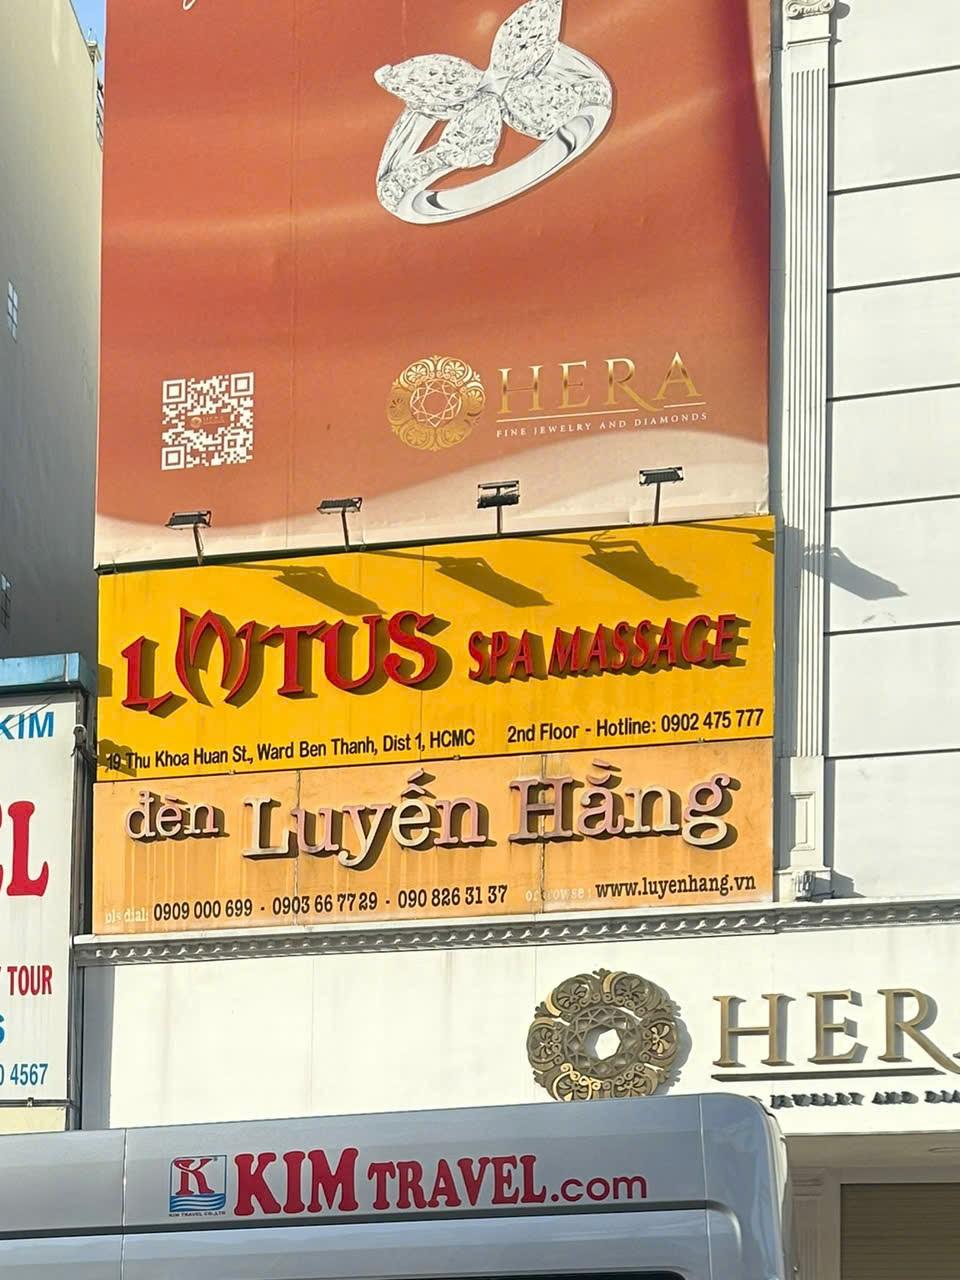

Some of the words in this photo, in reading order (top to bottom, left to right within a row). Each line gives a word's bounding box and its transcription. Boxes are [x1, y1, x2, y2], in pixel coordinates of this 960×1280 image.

[497, 351, 703, 414] HERA
[496, 426, 527, 438] FINE
[533, 422, 592, 435] JEWELRY
[599, 418, 627, 429] AND
[634, 411, 708, 427] DIAMONDS
[121, 607, 437, 711] LOTUS
[468, 629, 533, 682] SPA
[548, 613, 737, 675] MASSAGE
[507, 723, 537, 743] 2nd
[540, 721, 579, 741] Floor
[596, 714, 657, 737] Hotline:
[661, 713, 699, 734] 0902
[702, 711, 731, 731] 475
[735, 708, 764, 728] 777
[107, 753, 121, 770] 19
[125, 751, 151, 769] Thu
[155, 750, 189, 768] Khoa
[194, 747, 228, 764] Huan
[257, 741, 297, 760] Ward
[299, 738, 328, 757] Ben
[331, 736, 377, 757] Thanh,
[382, 733, 414, 753] Dist
[429, 729, 475, 749] HCMC
[125, 790, 219, 841] đèn
[243, 769, 487, 866] Luyến
[509, 758, 732, 846] Hằng
[153, 901, 190, 921] 0909
[193, 900, 221, 919] 000
[224, 897, 253, 918] 699
[272, 895, 310, 915] 0903
[314, 894, 333, 913] 66
[397, 889, 427, 909] 090
[431, 887, 461, 907] 826
[464, 886, 483, 905] 31
[487, 884, 508, 904] 37
[595, 874, 756, 900] www.luyenhang.vn
[7, 965, 53, 996] TOUR
[712, 987, 960, 1074] HER
[10, 1063, 48, 1085] 4567
[174, 1158, 216, 1195] K
[234, 1147, 359, 1218] KIM
